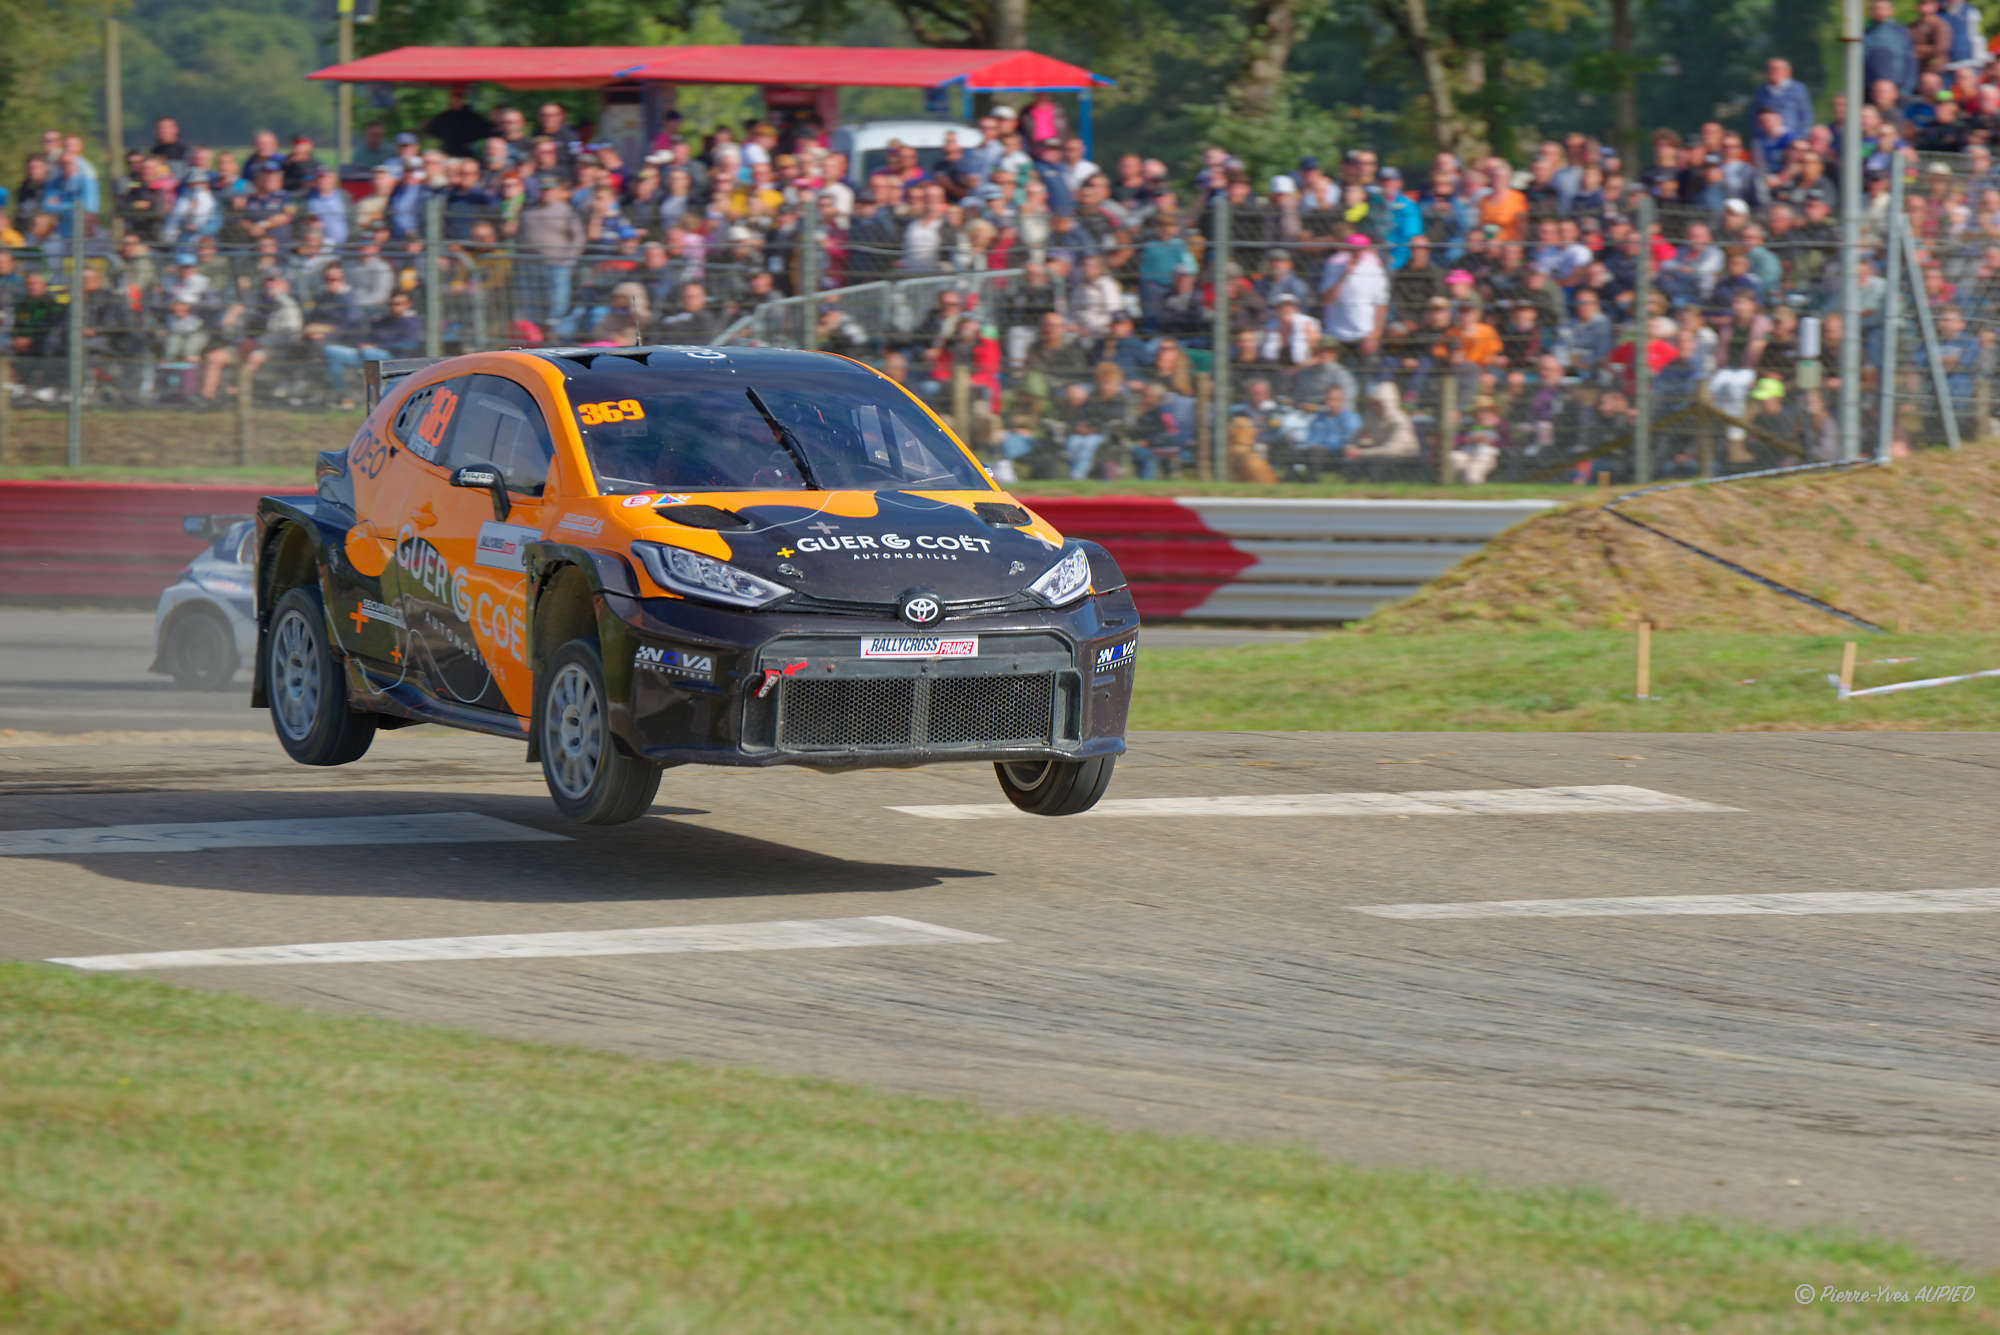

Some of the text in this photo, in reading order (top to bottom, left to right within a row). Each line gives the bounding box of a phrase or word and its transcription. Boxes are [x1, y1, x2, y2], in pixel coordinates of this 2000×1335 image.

[577, 399, 646, 425] 369
[796, 535, 880, 552] GUER
[915, 535, 991, 553] COËT
[853, 553, 958, 561] AUTOMOBILES
[396, 524, 448, 604] GUER
[477, 593, 527, 662] COË
[870, 637, 974, 655] RALLYCROSS FRANCE
